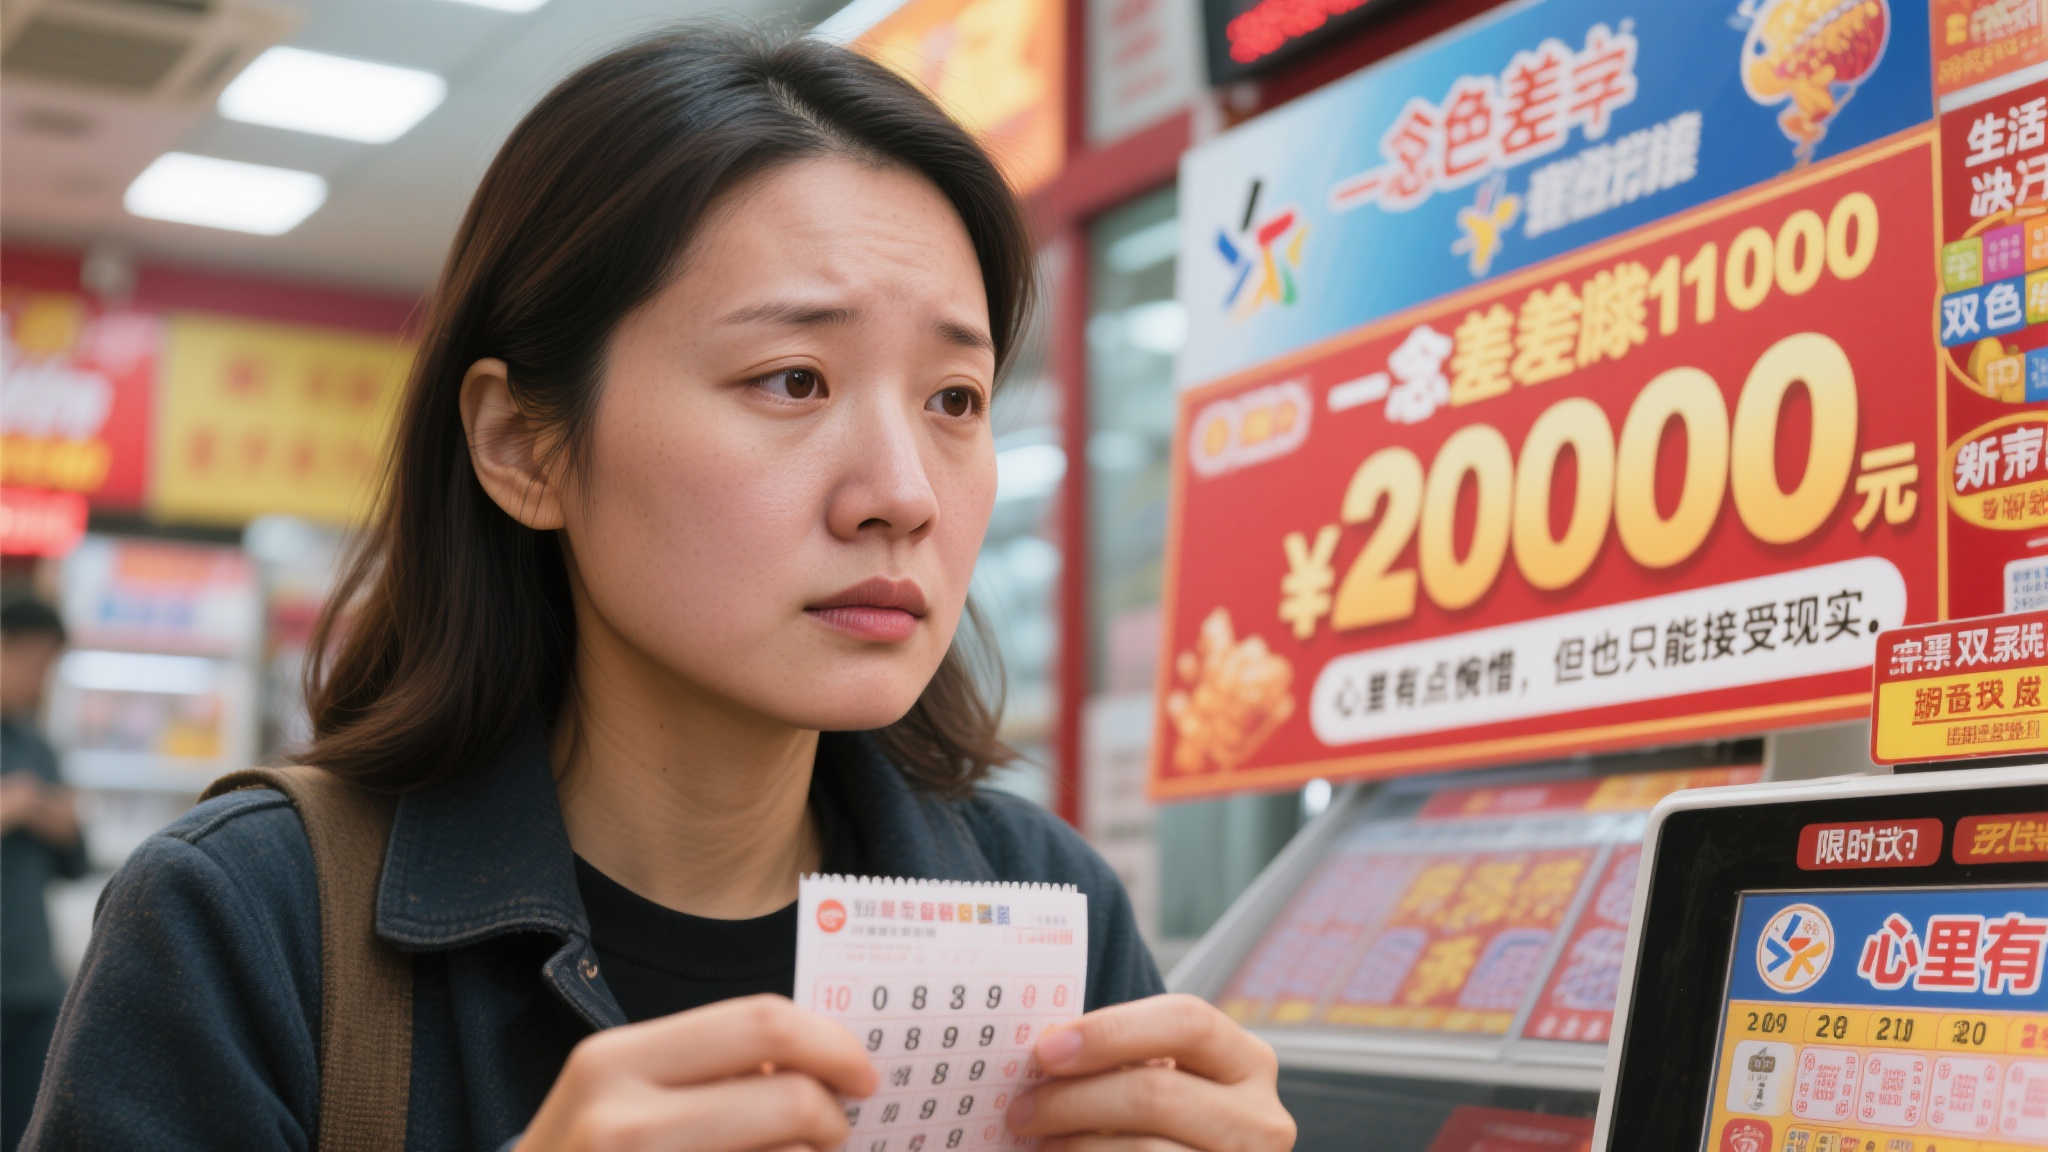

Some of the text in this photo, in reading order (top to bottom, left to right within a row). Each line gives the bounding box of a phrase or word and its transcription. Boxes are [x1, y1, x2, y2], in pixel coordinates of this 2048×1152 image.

[1964, 96, 2048, 168] 生活
[1942, 283, 2023, 340] 双色
[1858, 913, 2047, 995] 心里有
